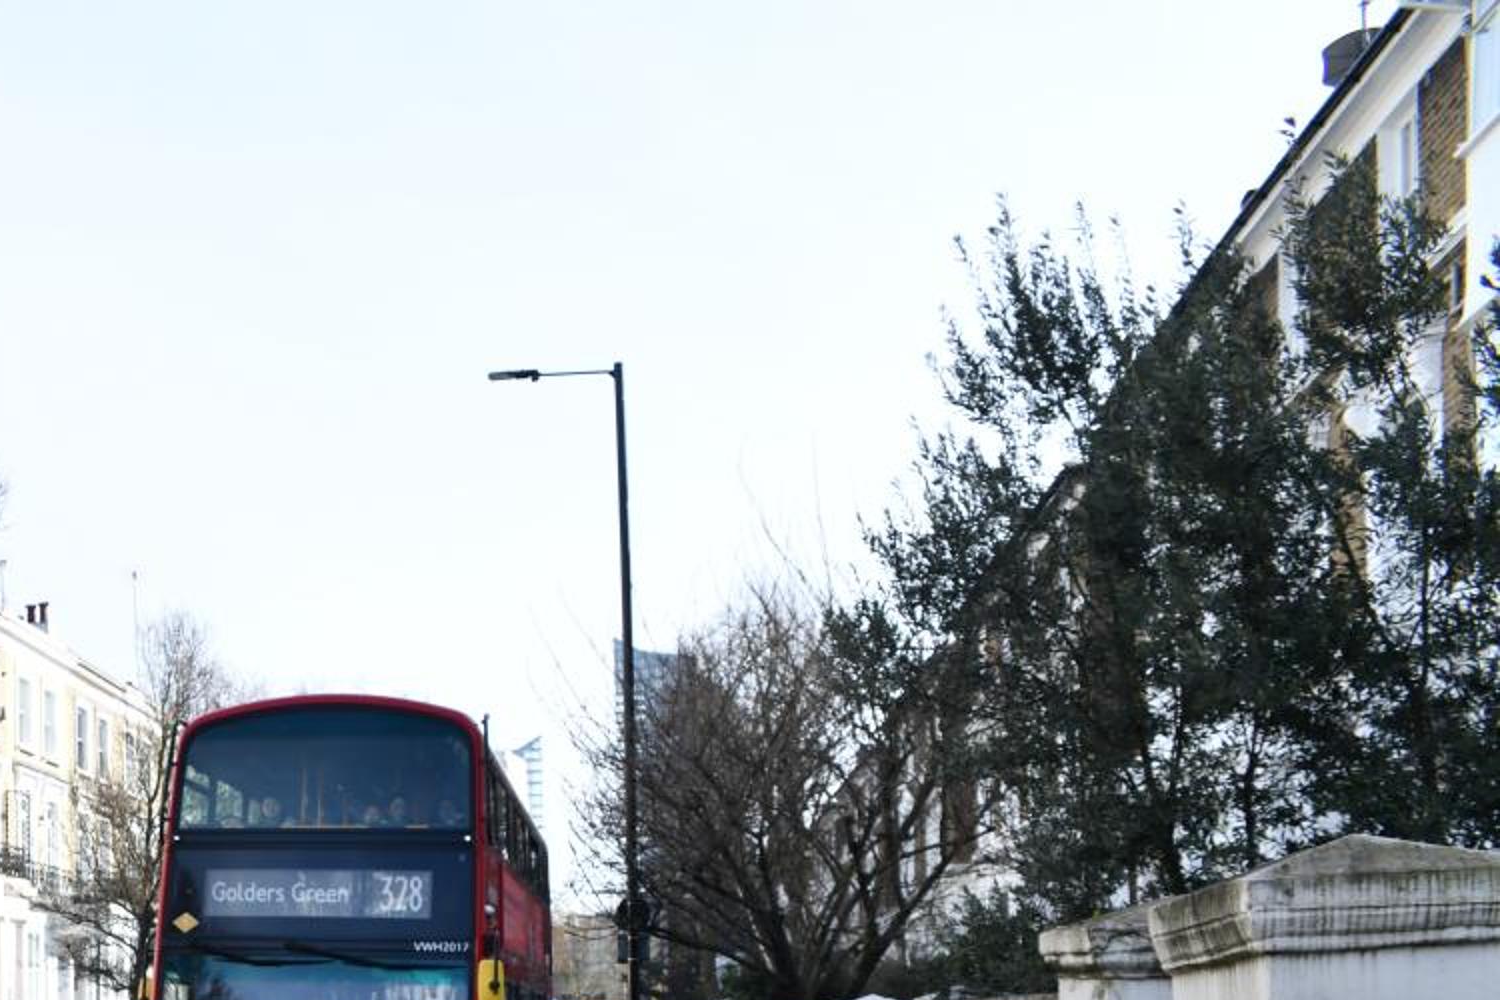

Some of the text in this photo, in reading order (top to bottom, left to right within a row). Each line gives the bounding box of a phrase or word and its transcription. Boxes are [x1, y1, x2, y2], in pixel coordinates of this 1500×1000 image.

[211, 880, 349, 904] Golders Green
[379, 875, 423, 912] 328
[413, 940, 469, 952] VWH2017
